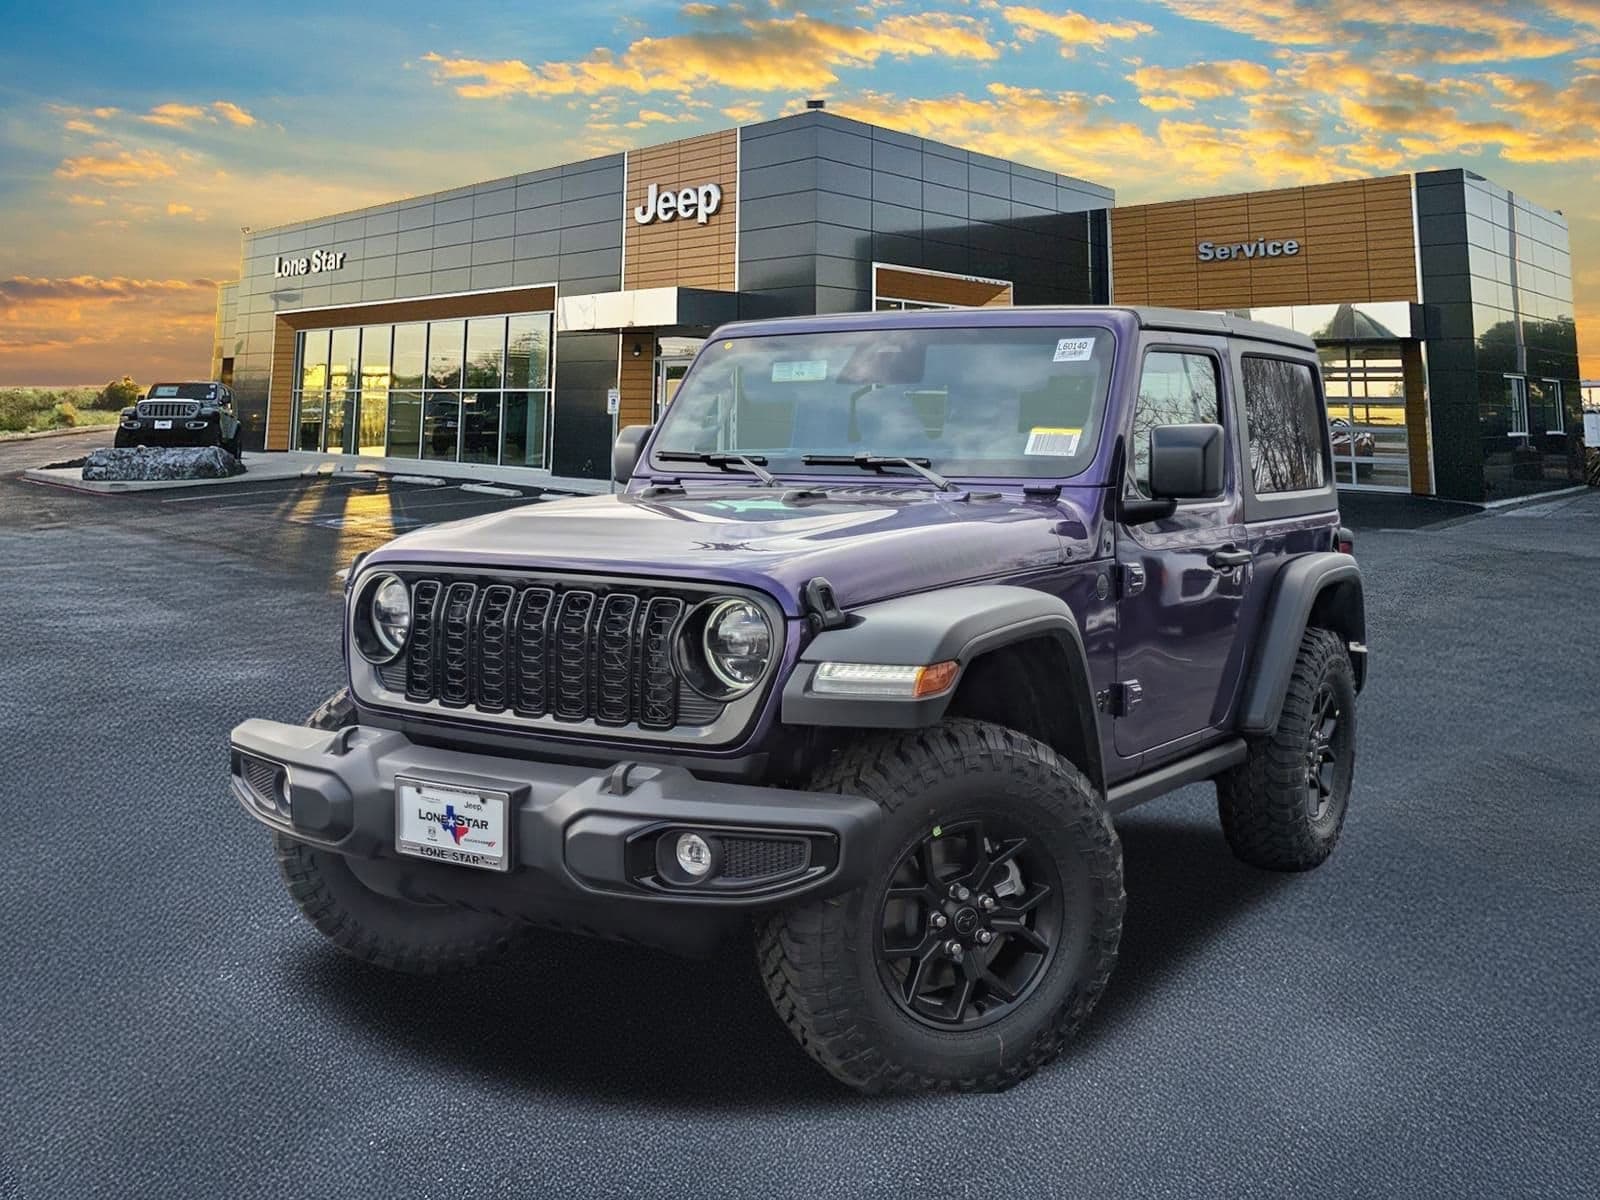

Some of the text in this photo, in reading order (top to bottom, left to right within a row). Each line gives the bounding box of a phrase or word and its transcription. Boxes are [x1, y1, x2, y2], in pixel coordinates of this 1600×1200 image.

[634, 183, 722, 225] Jeep
[1198, 237, 1300, 261] Service
[275, 249, 346, 278] Lone Star
[420, 846, 448, 859] LONE
[452, 852, 480, 865] STAR
